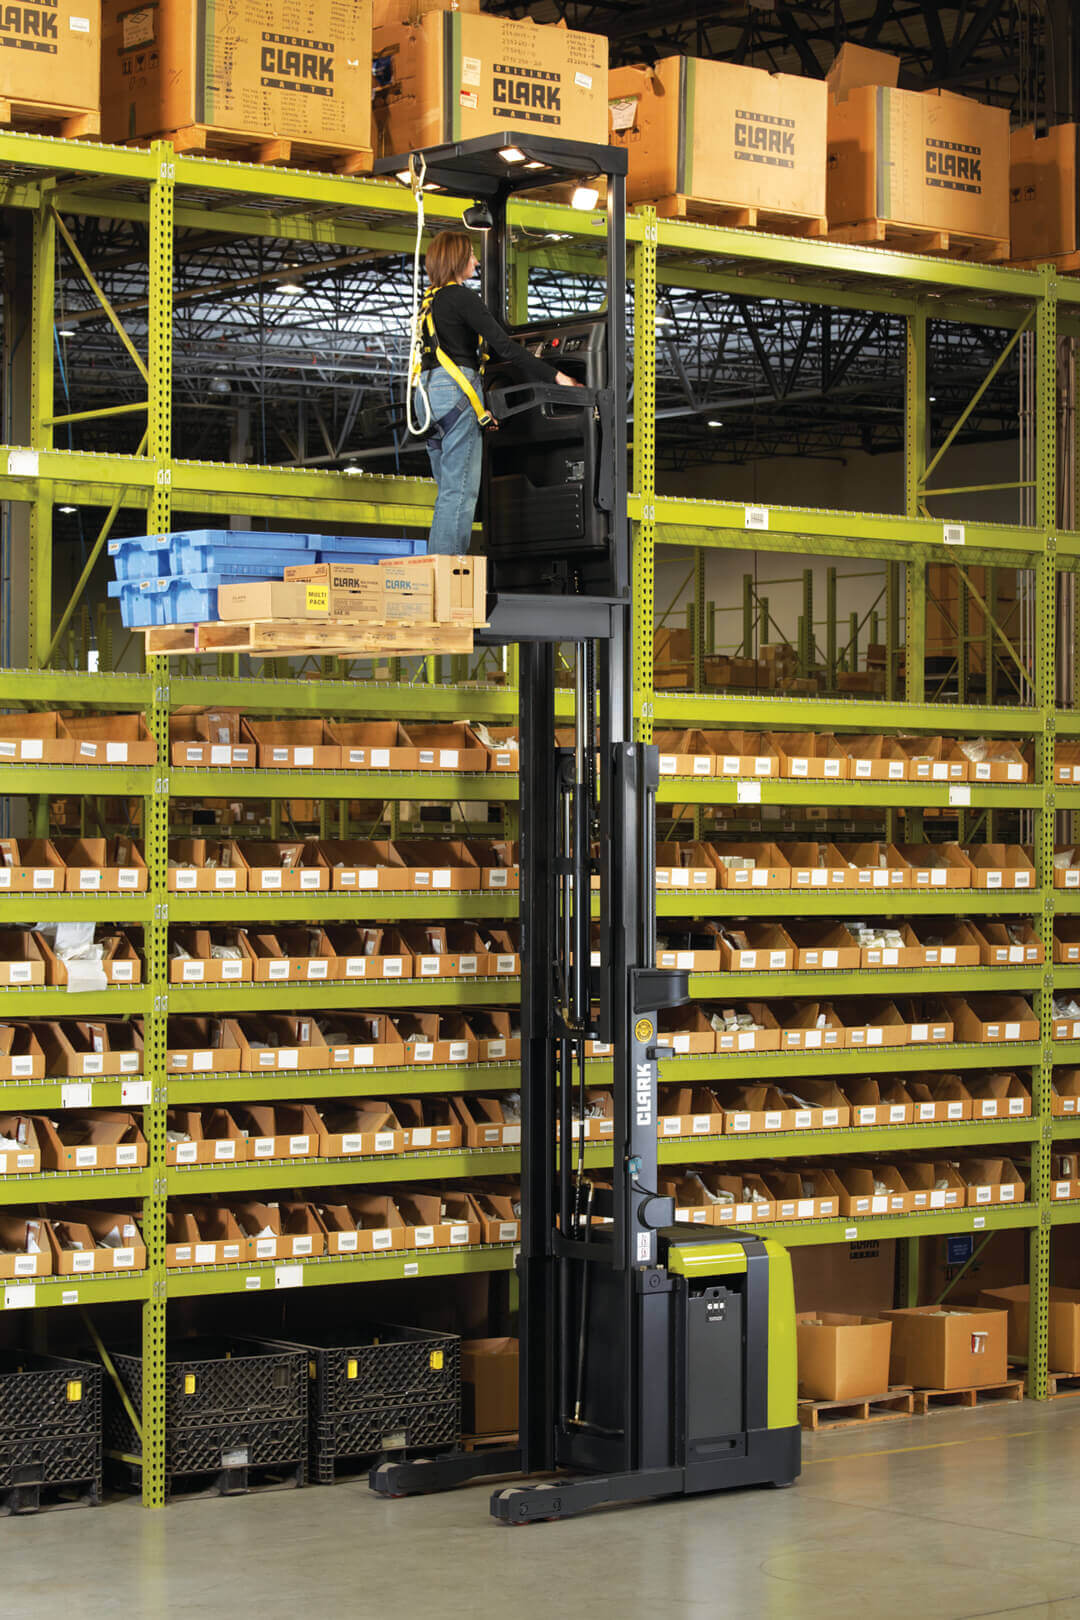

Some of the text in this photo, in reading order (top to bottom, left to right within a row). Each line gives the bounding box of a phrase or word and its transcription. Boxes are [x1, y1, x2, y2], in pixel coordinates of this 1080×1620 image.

[0, 5, 57, 39] LARK
[263, 33, 334, 52] ORIGINAL
[261, 47, 334, 82] CLARK
[262, 78, 332, 96] PARTS
[493, 78, 561, 111] CLARK
[494, 108, 560, 124] PARTS
[735, 123, 795, 155] CLARK
[926, 151, 982, 181] CLARK
[333, 577, 360, 588] CLARK
[385, 579, 412, 590] CLARK
[637, 1063, 651, 1126] CLARK
